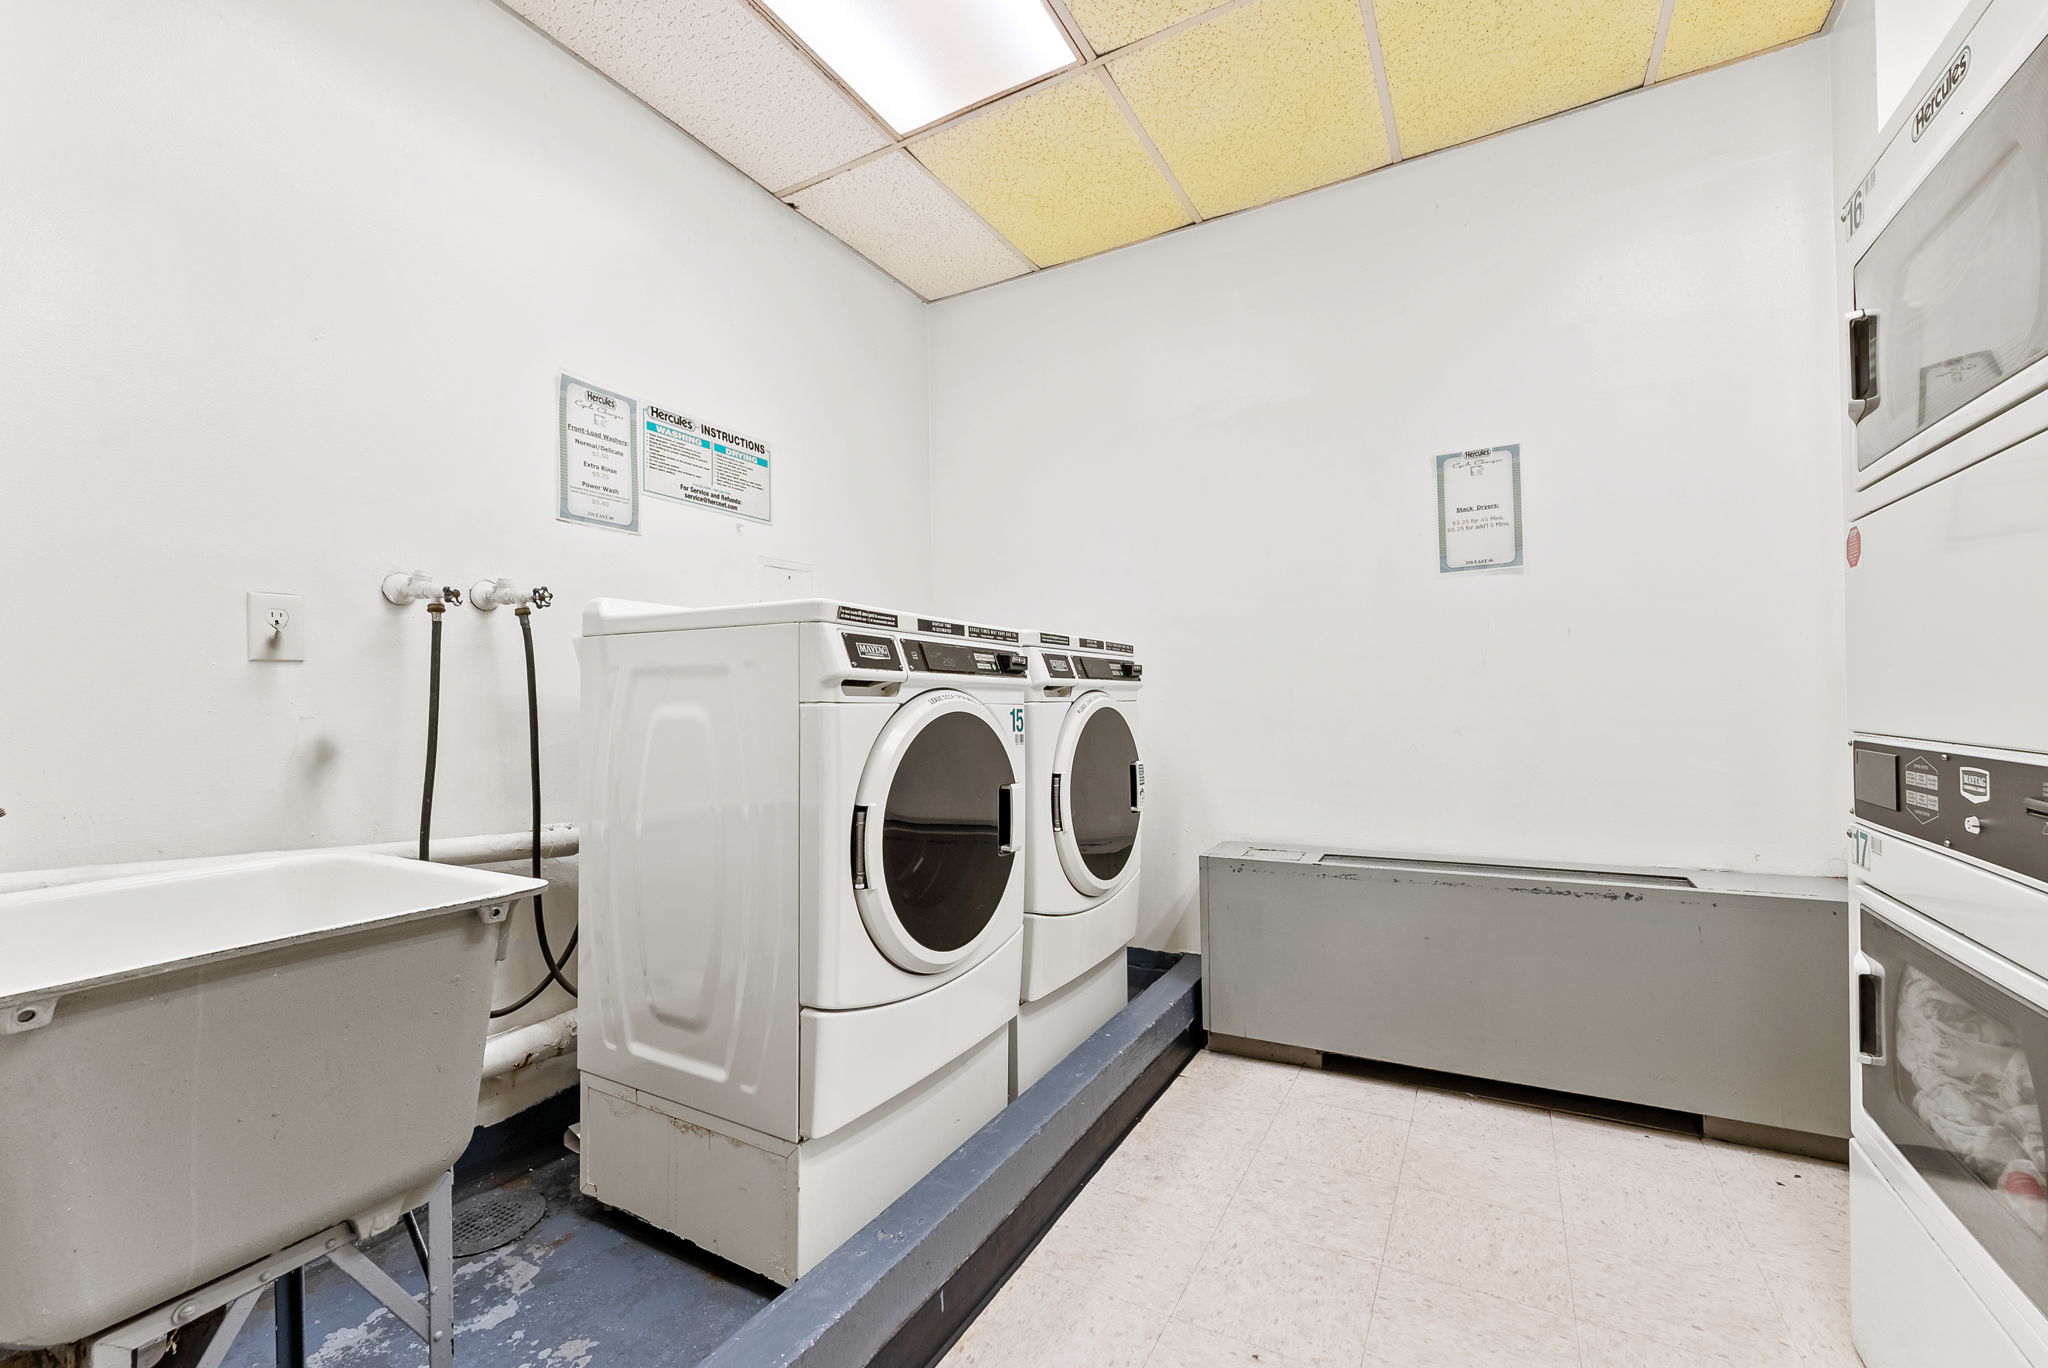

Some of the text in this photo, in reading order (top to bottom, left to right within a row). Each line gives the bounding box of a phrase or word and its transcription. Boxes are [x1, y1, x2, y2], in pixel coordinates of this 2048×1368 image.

[1915, 53, 1967, 136] Hercules
[1847, 190, 1862, 237] 16
[587, 390, 616, 408] Hercules
[568, 423, 602, 438] Front-Load
[650, 406, 766, 454] Hercules INSTRUCTIONS
[656, 425, 702, 447] WASHING
[575, 438, 624, 457] Normal/Delicate
[725, 448, 758, 464] DRYING
[1465, 449, 1490, 458] Hercules
[584, 461, 618, 475] Extra Rinse
[582, 481, 619, 494] Power Wash
[680, 484, 690, 492] For
[690, 487, 710, 497] Service
[711, 491, 720, 500] and
[721, 494, 742, 505] Refunds:
[1477, 503, 1500, 511] Dryers:
[858, 644, 889, 655] MAYTAG
[1010, 708, 1024, 732] 15
[1963, 774, 1986, 787] MAYTAG
[1853, 830, 1868, 867] 17
